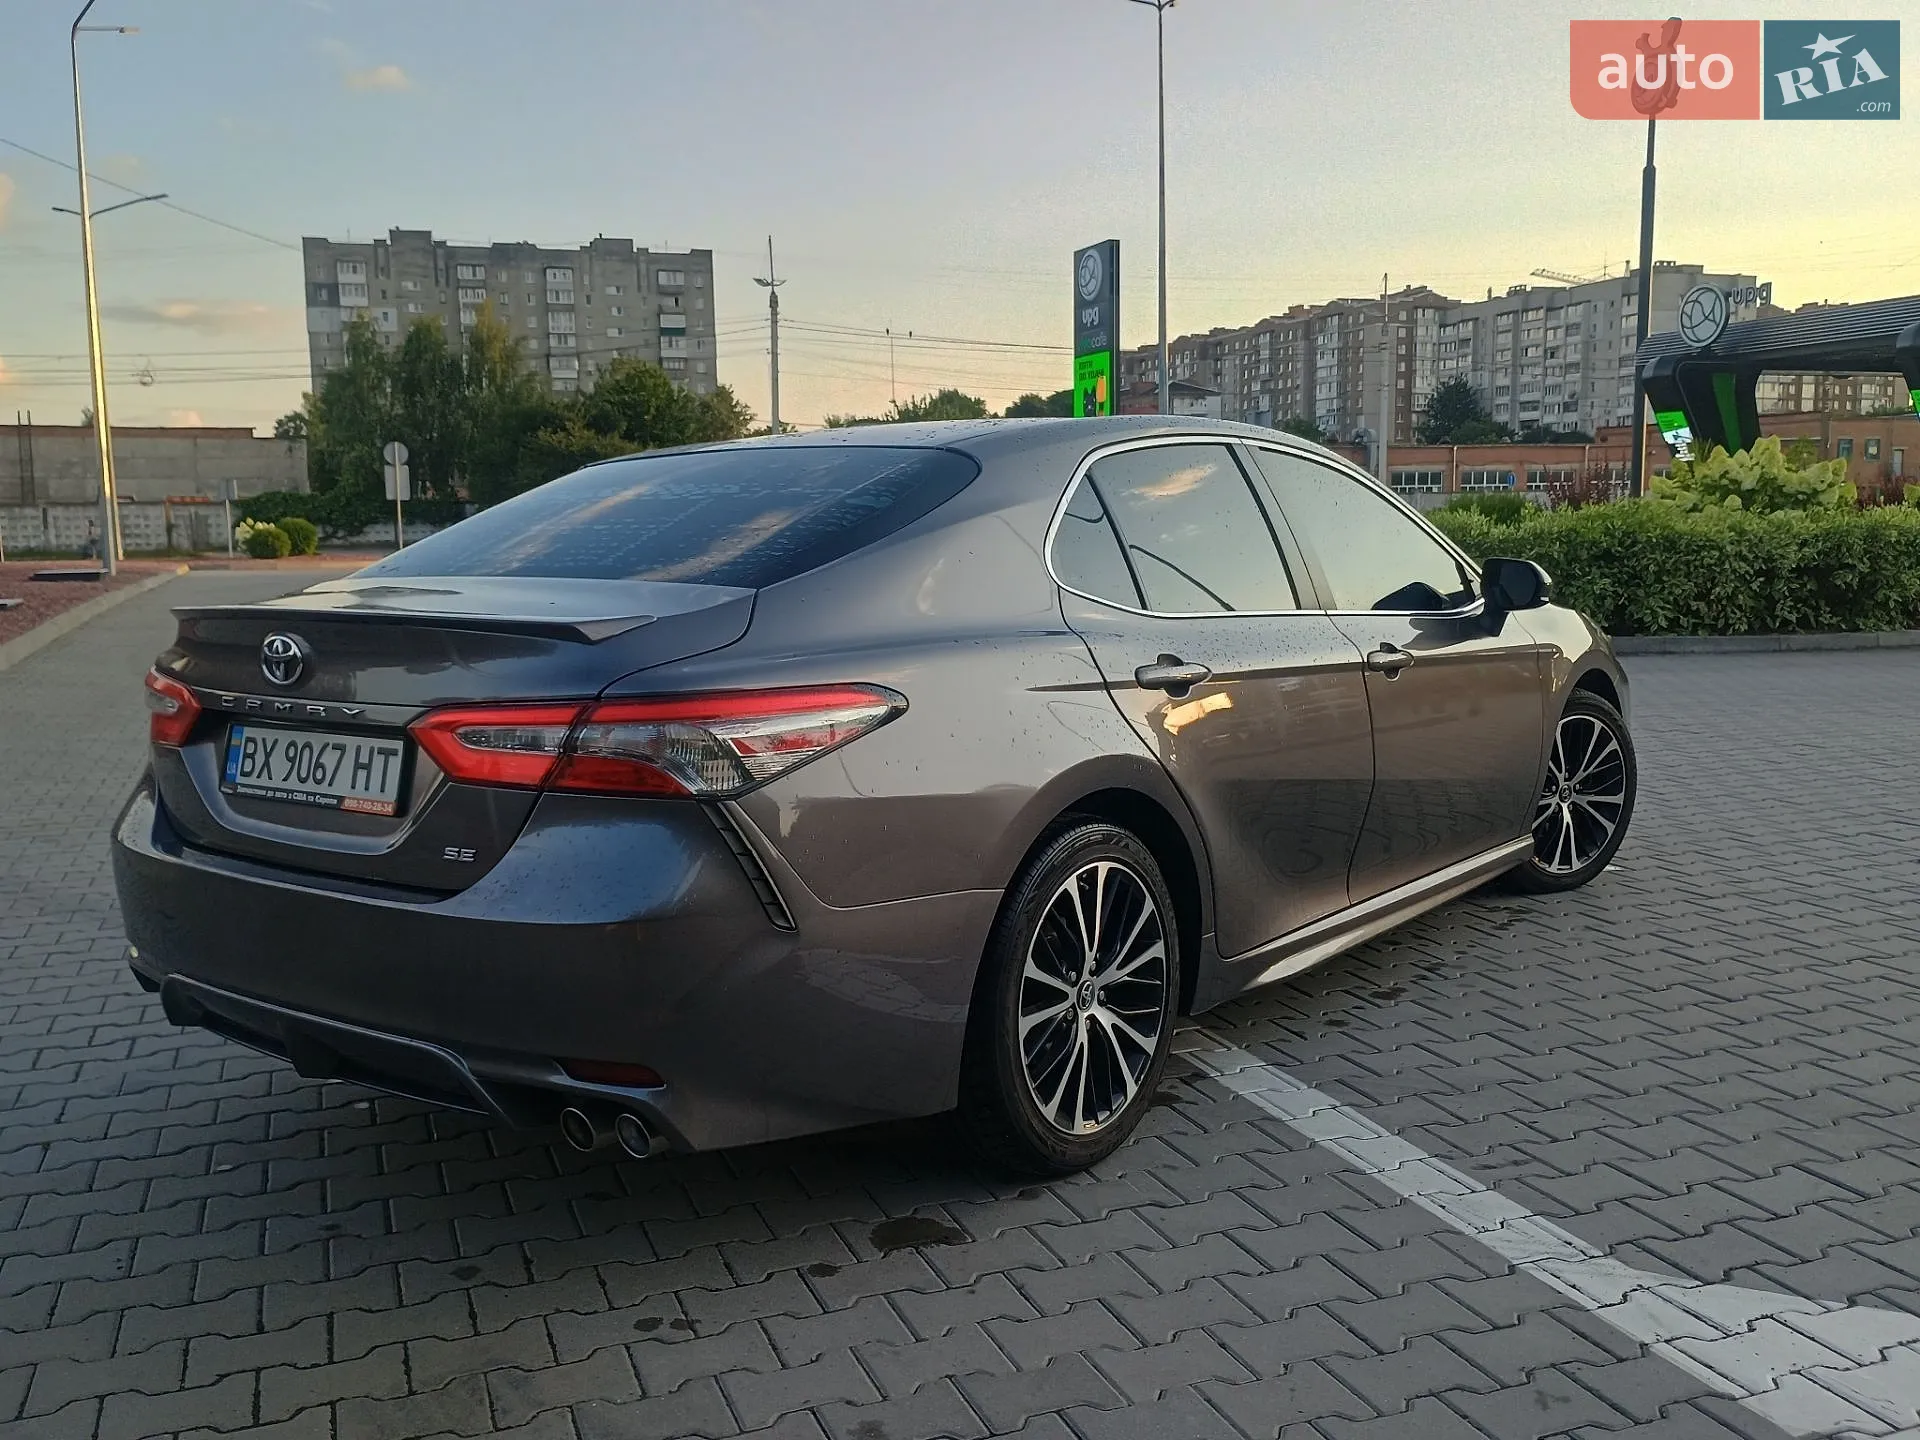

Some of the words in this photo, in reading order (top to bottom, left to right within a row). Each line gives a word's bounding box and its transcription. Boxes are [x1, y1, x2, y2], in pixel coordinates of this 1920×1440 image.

[1732, 281, 1772, 308] upg
[1082, 306, 1099, 326] upg
[221, 696, 367, 716] CAMRY
[240, 735, 279, 781] BX
[281, 741, 347, 788] 9067
[351, 744, 399, 793] HT
[442, 847, 477, 862] SE
